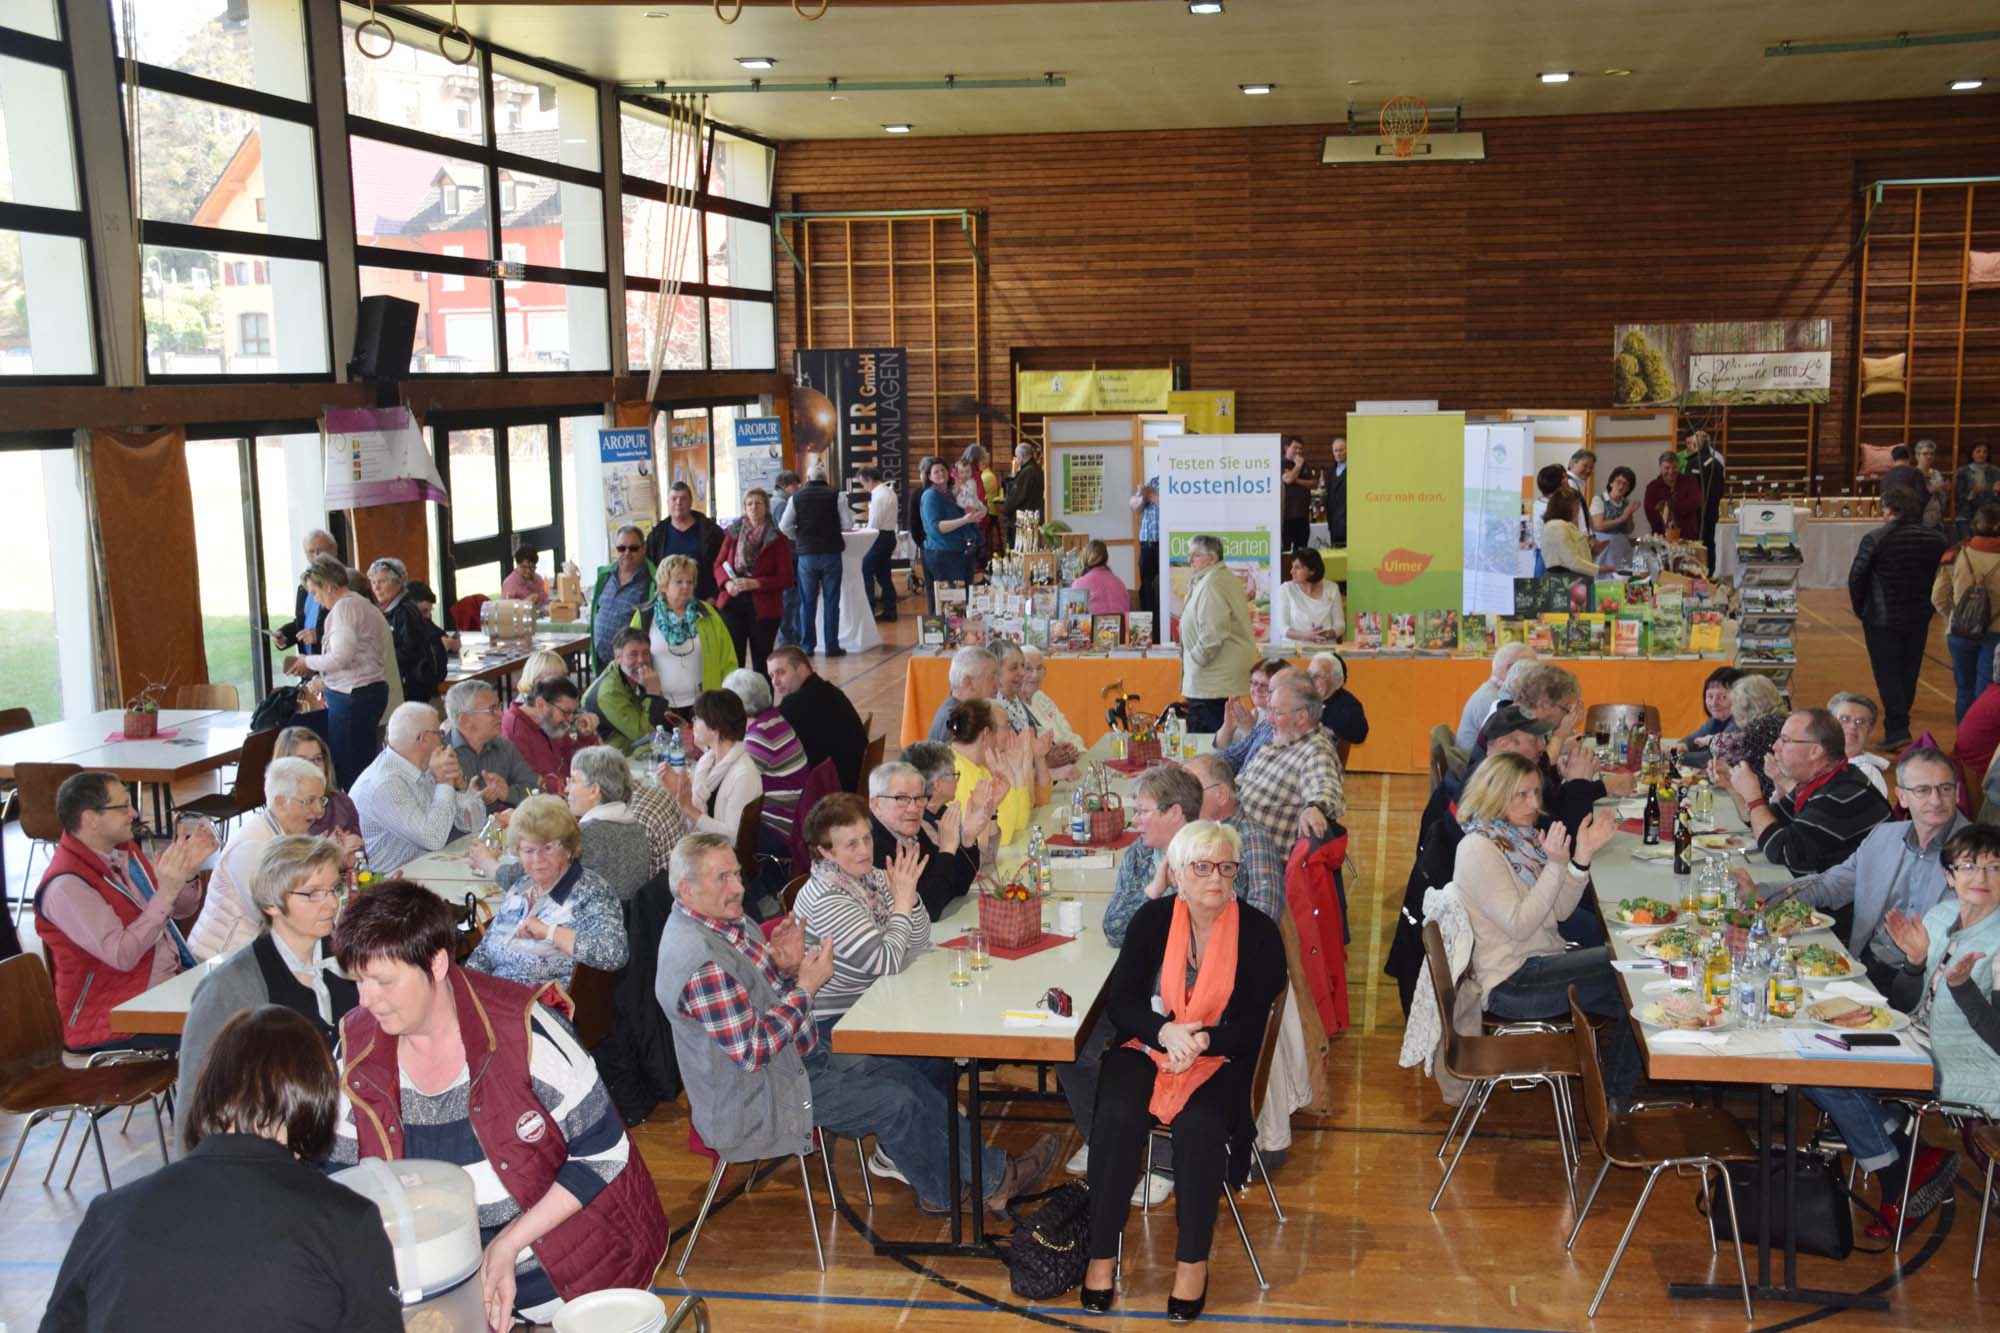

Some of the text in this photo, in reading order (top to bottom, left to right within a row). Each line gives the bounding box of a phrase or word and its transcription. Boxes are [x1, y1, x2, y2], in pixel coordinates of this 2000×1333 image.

[857, 353, 877, 397] GmbH
[1773, 365, 1798, 378] CHOCO
[738, 422, 778, 436] AROPUR
[602, 434, 648, 450] AROPUR
[1169, 456, 1271, 470] Testen Sie uns
[1168, 474, 1272, 495] kostenlos!
[1365, 491, 1393, 503] Ganz
[1395, 489, 1415, 503] nah
[1220, 536, 1269, 557] Garten
[1384, 560, 1423, 572] Ulmer
